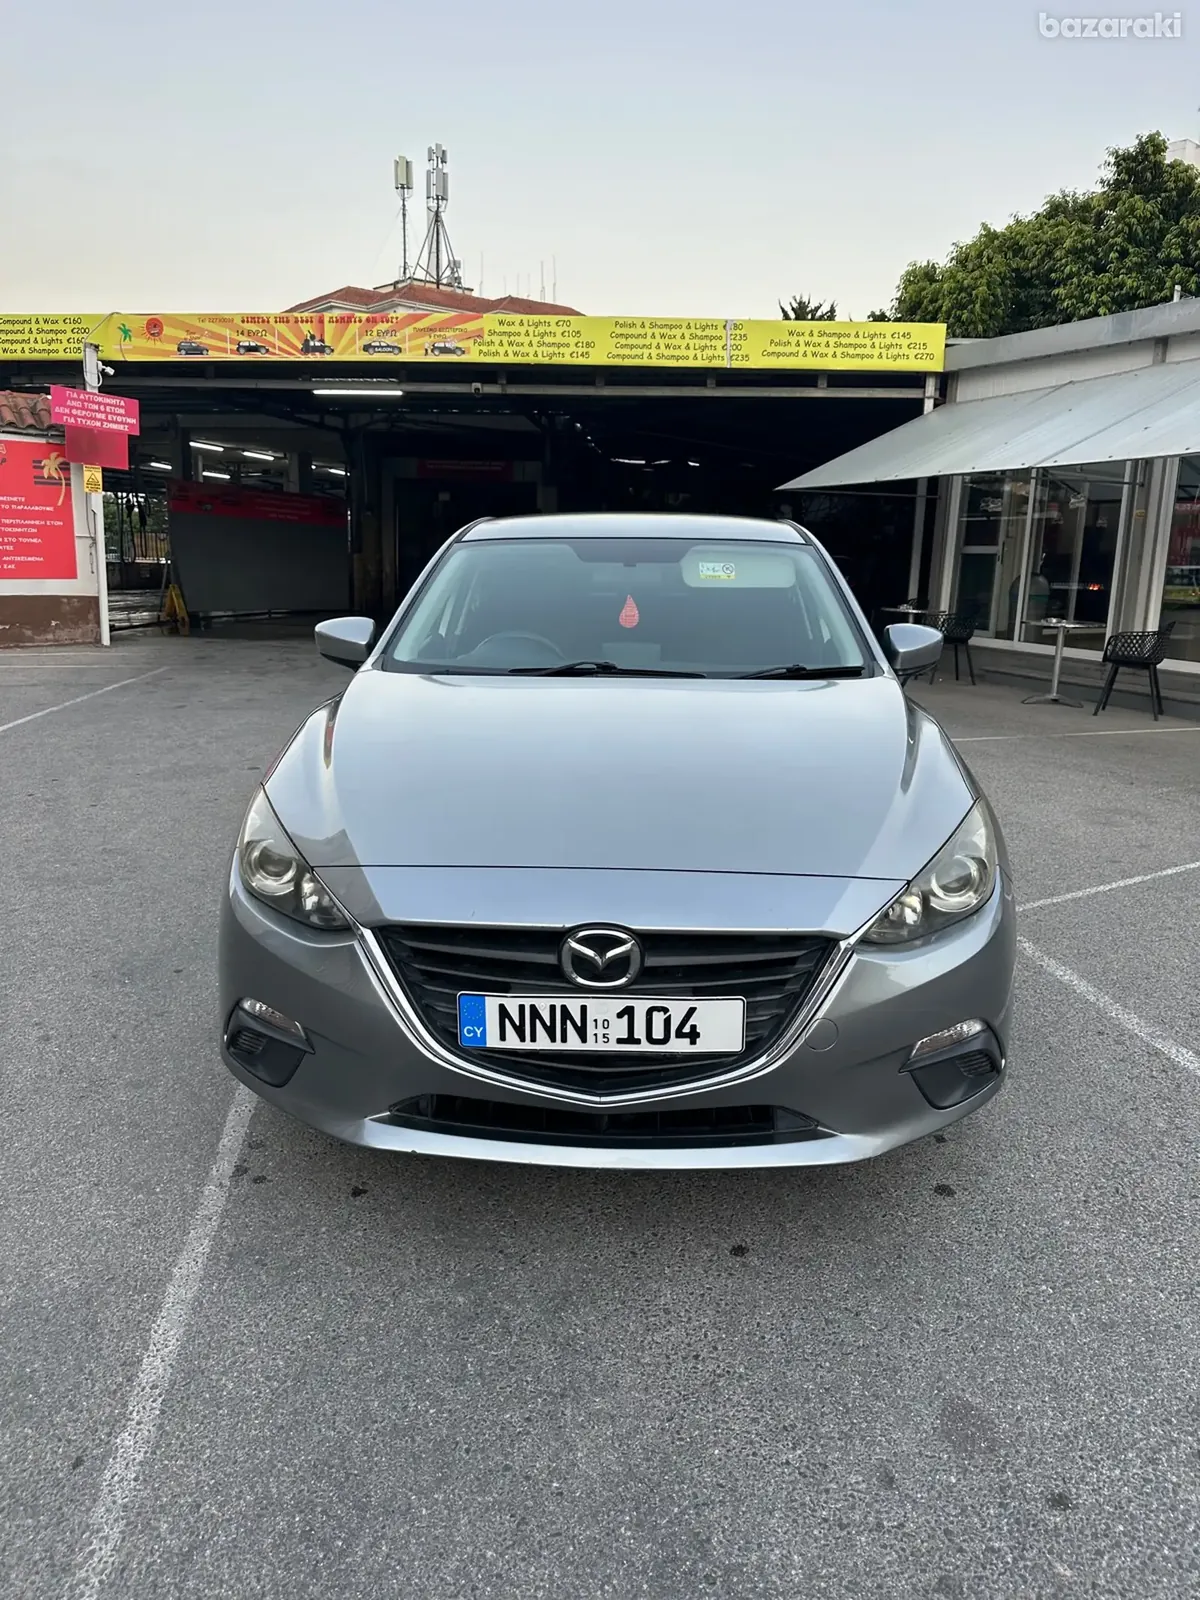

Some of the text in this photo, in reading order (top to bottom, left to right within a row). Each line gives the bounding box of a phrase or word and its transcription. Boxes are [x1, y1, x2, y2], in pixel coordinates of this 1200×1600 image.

[498, 319, 515, 327] Wax
[519, 319, 524, 327] &
[528, 319, 551, 329] Lights
[615, 321, 637, 329] Polish
[649, 322, 682, 330] Shampoo
[686, 322, 691, 330] &
[694, 322, 718, 332] Lights
[36, 327, 67, 336] Shampoo
[247, 329, 267, 337] ΕΥΡΩ
[488, 329, 521, 338] Shampoo
[533, 330, 556, 339] Lights
[561, 330, 581, 338] €105
[610, 331, 647, 340] Compound
[689, 333, 722, 342] Shampoo
[788, 329, 805, 337] Wax
[817, 330, 851, 339] Shampoo
[854, 330, 859, 338] &
[863, 331, 886, 340] Lights
[41, 337, 63, 346] Lights
[474, 339, 495, 347] Polish
[528, 340, 533, 348] &
[537, 340, 570, 349] Shampoo
[615, 342, 652, 351] Compound
[655, 342, 660, 350] &
[693, 343, 717, 352] Lights
[770, 339, 792, 347] Polish
[804, 340, 821, 348] Wax
[834, 341, 867, 350] Shampoo
[879, 342, 902, 352] Lights
[28, 347, 59, 356] Shampoo
[479, 349, 500, 357] Polish
[533, 350, 538, 358] &
[542, 350, 565, 360] Lights
[762, 349, 799, 359] Compound
[802, 350, 808, 358] &
[832, 351, 837, 359] &
[840, 352, 874, 361] Shampoo
[877, 352, 883, 360] &
[886, 353, 909, 362] Lights
[914, 353, 935, 361] €270
[607, 352, 644, 361] Compound
[647, 352, 652, 360] &
[656, 352, 689, 362] Shampoo
[701, 354, 724, 363] Lights
[80, 394, 125, 406] ΑΥΤΟΚΙΝΗΤΑ
[84, 402, 98, 410] ΤΩΝ
[106, 405, 125, 414] ΕΤΩΝ
[55, 406, 136, 424] ΔΕΝ ΦΕΡΟΥΜΕ ΕΥΘΥΝΗ
[77, 418, 101, 427] ΤΥΧΟΝ
[103, 422, 129, 431] ΖΗΜΙΕΣ
[498, 1003, 700, 1045] NNN 104
[592, 1018, 610, 1030] 10
[464, 1026, 484, 1038] CY
[593, 1032, 610, 1044] 15
